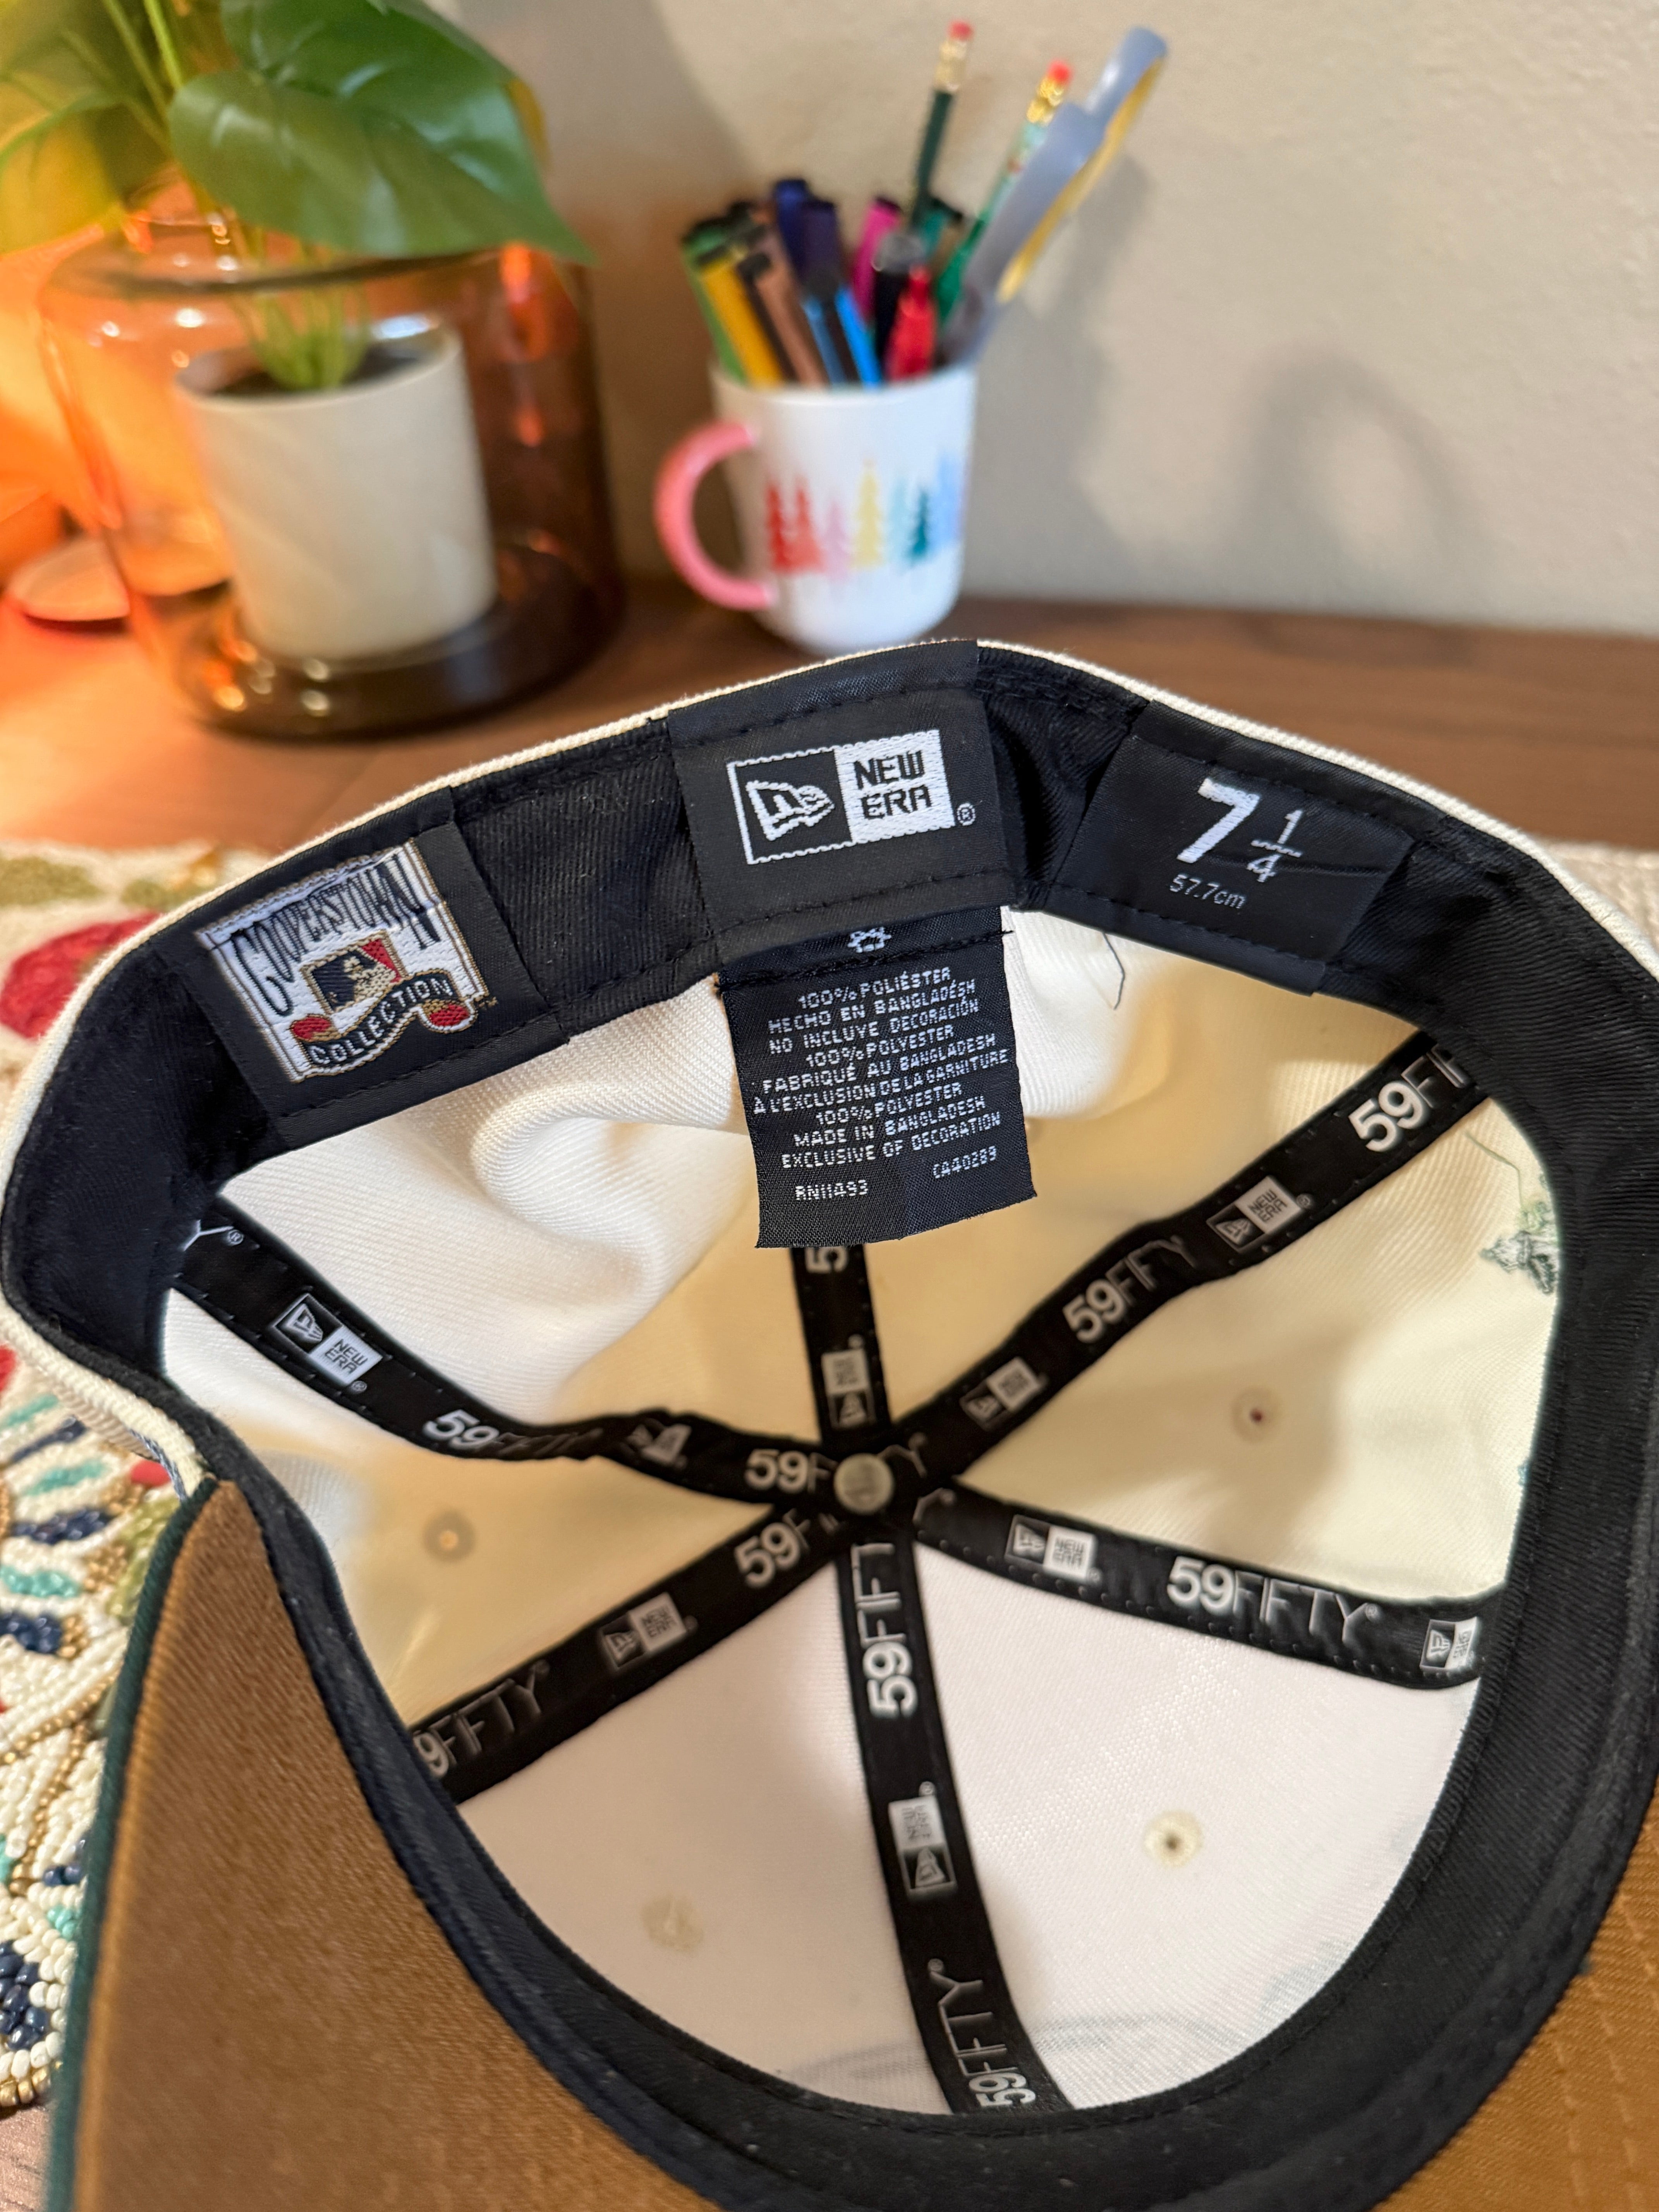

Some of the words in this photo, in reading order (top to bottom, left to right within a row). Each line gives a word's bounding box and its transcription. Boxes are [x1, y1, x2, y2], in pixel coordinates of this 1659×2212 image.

[853, 750, 925, 789] NEW
[860, 784, 932, 820] ERA
[1176, 778, 1261, 864] 7
[1170, 874, 1246, 909] 57.7cm
[798, 987, 857, 1009] 100%
[860, 967, 950, 998] POLIÉSTER
[310, 977, 453, 1066] COLLECTION
[768, 1010, 831, 1034] HECHO
[840, 1004, 866, 1022] EN
[769, 1038, 793, 1054] NO
[803, 1021, 879, 1048] INCLUYE
[805, 1046, 864, 1067] 100%
[866, 1024, 954, 1058] POLYESTER
[867, 1060, 891, 1078] AU
[900, 1033, 996, 1072] BANGLADESH
[879, 1080, 901, 1096] DE
[904, 1072, 924, 1090] LA
[926, 1049, 1008, 1084] GARNITURE
[793, 1129, 847, 1147] MADE
[854, 1125, 874, 1140] IN
[884, 1096, 986, 1136] BANGLADESH
[816, 1106, 873, 1125] 100%
[874, 1082, 962, 1118] POLYESTER
[781, 1145, 876, 1168] EXCLUSIVE
[882, 1140, 903, 1158] OF
[911, 1111, 1001, 1151] DECORATION
[324, 1348, 359, 1374] ERA
[334, 1338, 368, 1366] NEW
